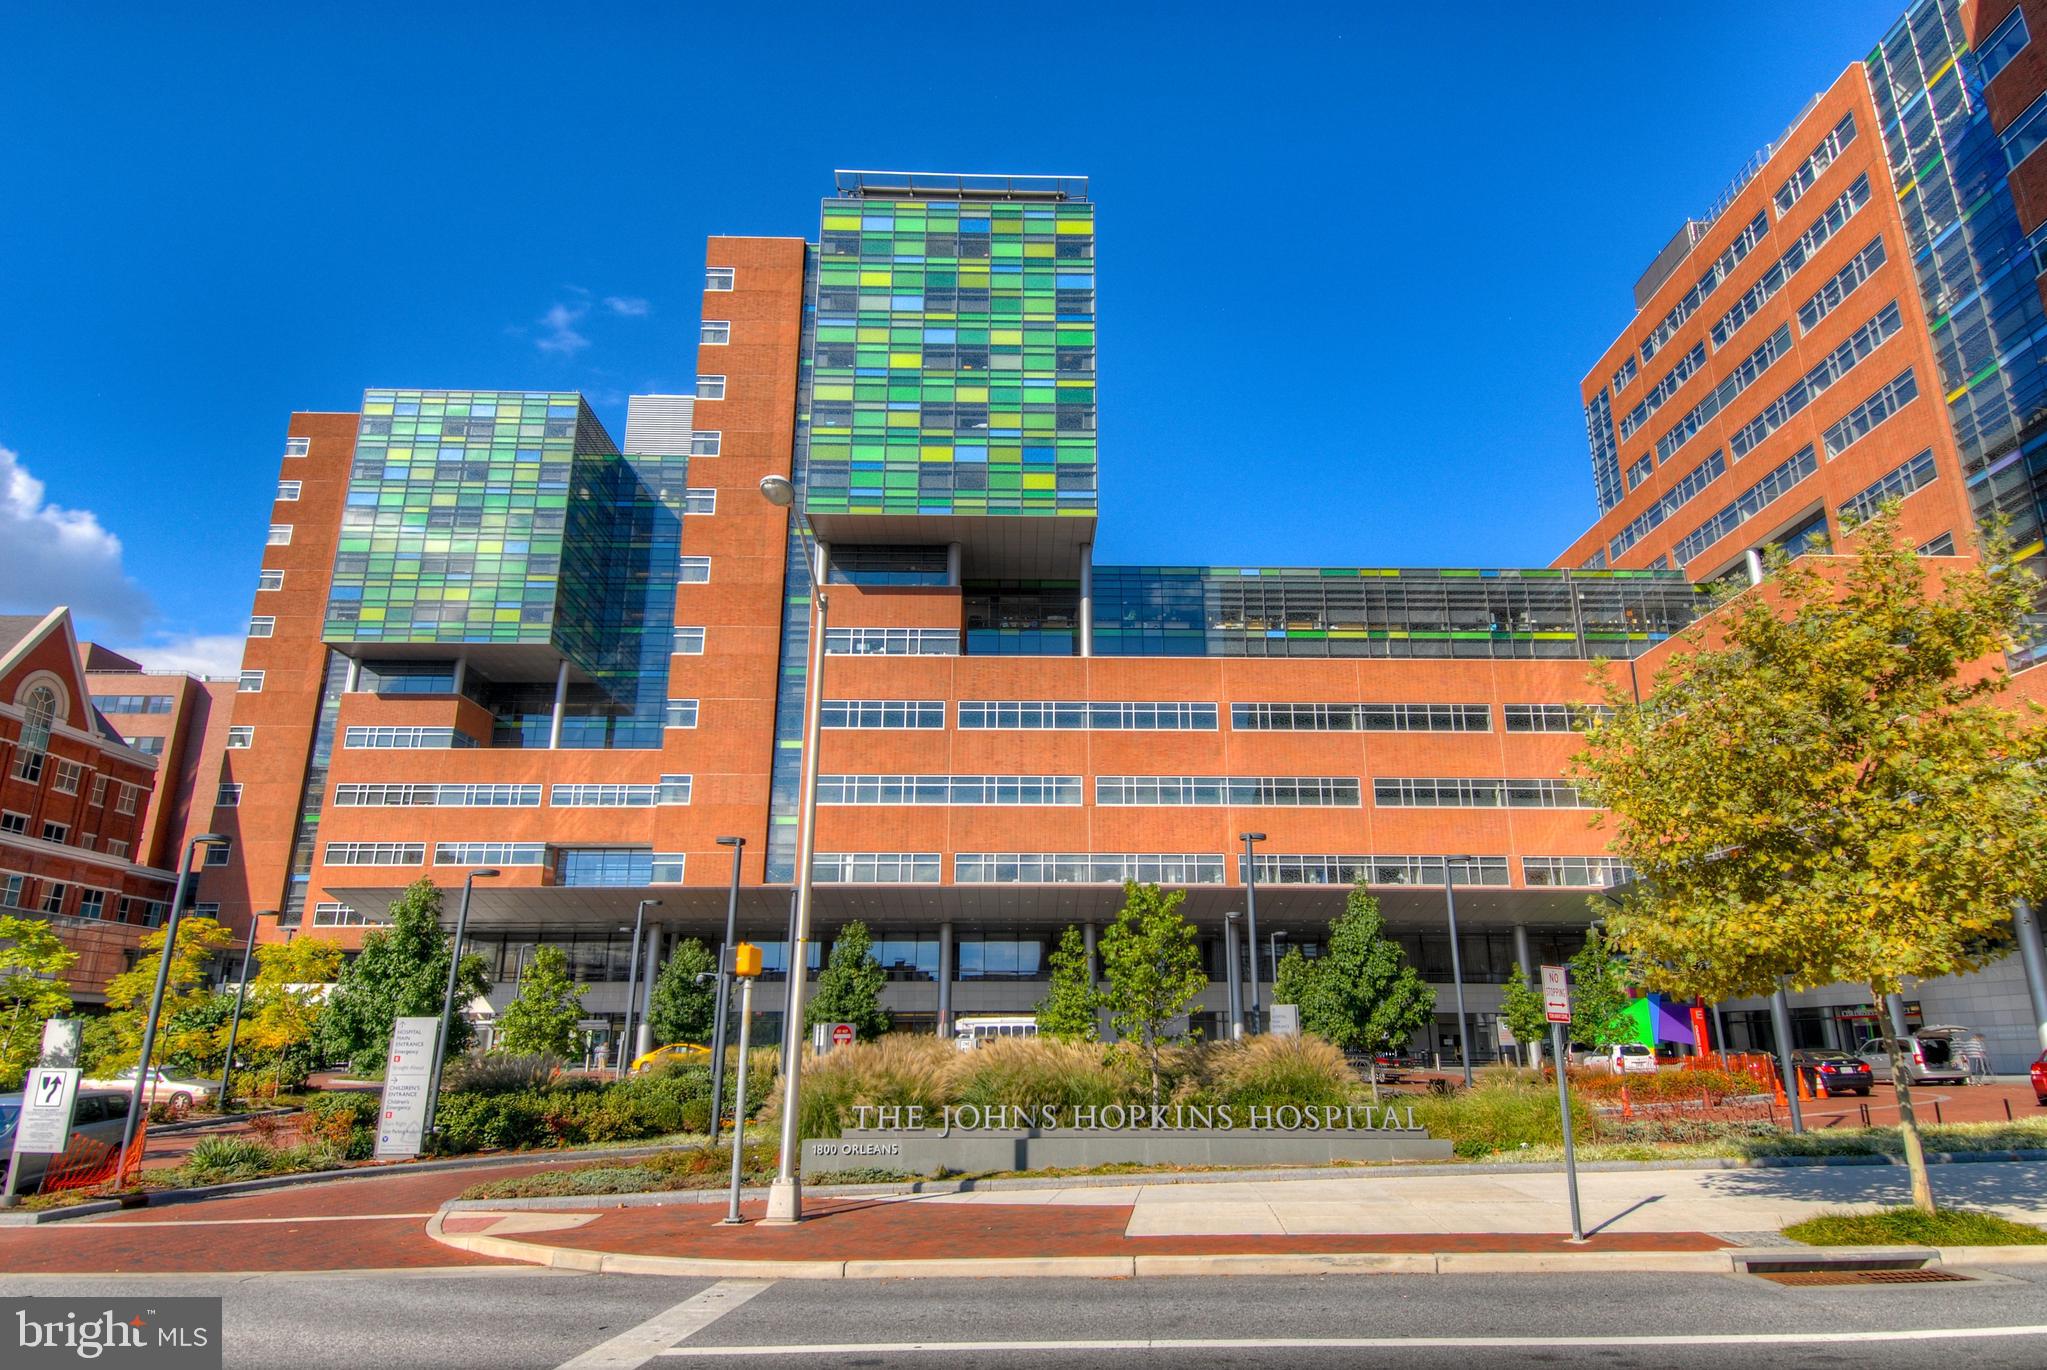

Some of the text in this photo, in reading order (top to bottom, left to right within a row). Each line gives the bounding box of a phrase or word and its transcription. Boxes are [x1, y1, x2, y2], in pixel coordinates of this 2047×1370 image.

[1549, 973, 1559, 983] NO
[852, 1104, 1424, 1138] THE JOHNS HOPKINS HOSPITAL
[812, 1144, 899, 1156] 1800 ORLEANS
